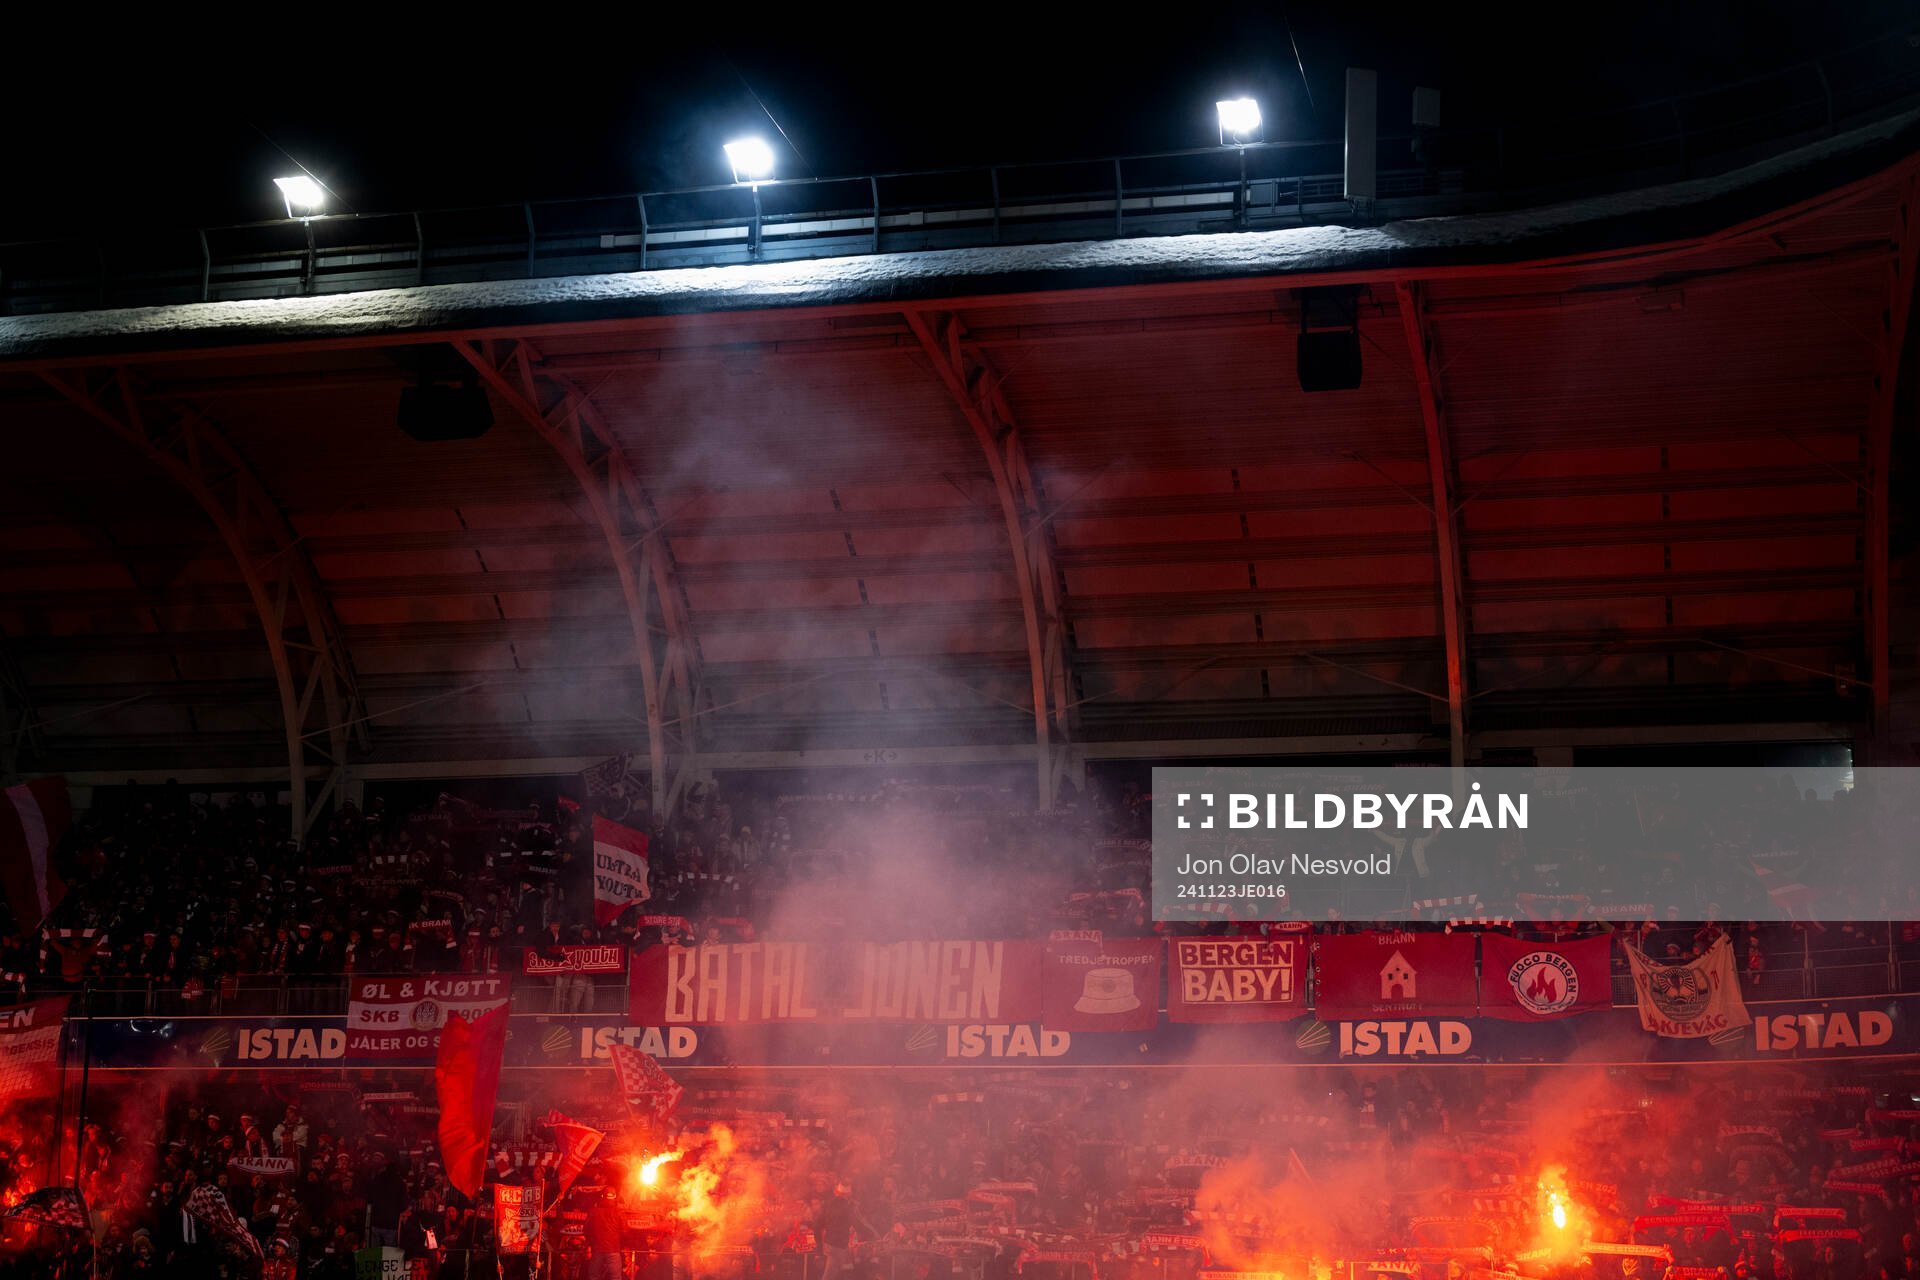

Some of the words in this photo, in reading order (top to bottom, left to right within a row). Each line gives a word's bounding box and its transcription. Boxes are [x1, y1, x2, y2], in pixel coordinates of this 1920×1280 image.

[1181, 942, 1292, 966] BERGEN
[362, 984, 391, 998] ØL
[400, 983, 414, 998] &
[423, 979, 500, 997] KJØTT
[1184, 968, 1291, 1001] BABY!
[1509, 955, 1540, 983] FUOCO
[1545, 954, 1577, 993] BERGEN
[359, 1010, 399, 1023] SKB
[1755, 1011, 1893, 1050] ISTAD
[238, 1028, 346, 1060] ISTAD
[350, 1036, 400, 1050] JÅLER
[406, 1036, 428, 1048] OG
[580, 1026, 697, 1059] ISTAD
[946, 1025, 1072, 1058] ISTAD
[1340, 1021, 1472, 1056] ISTAD
[236, 1157, 287, 1169] BRANN
